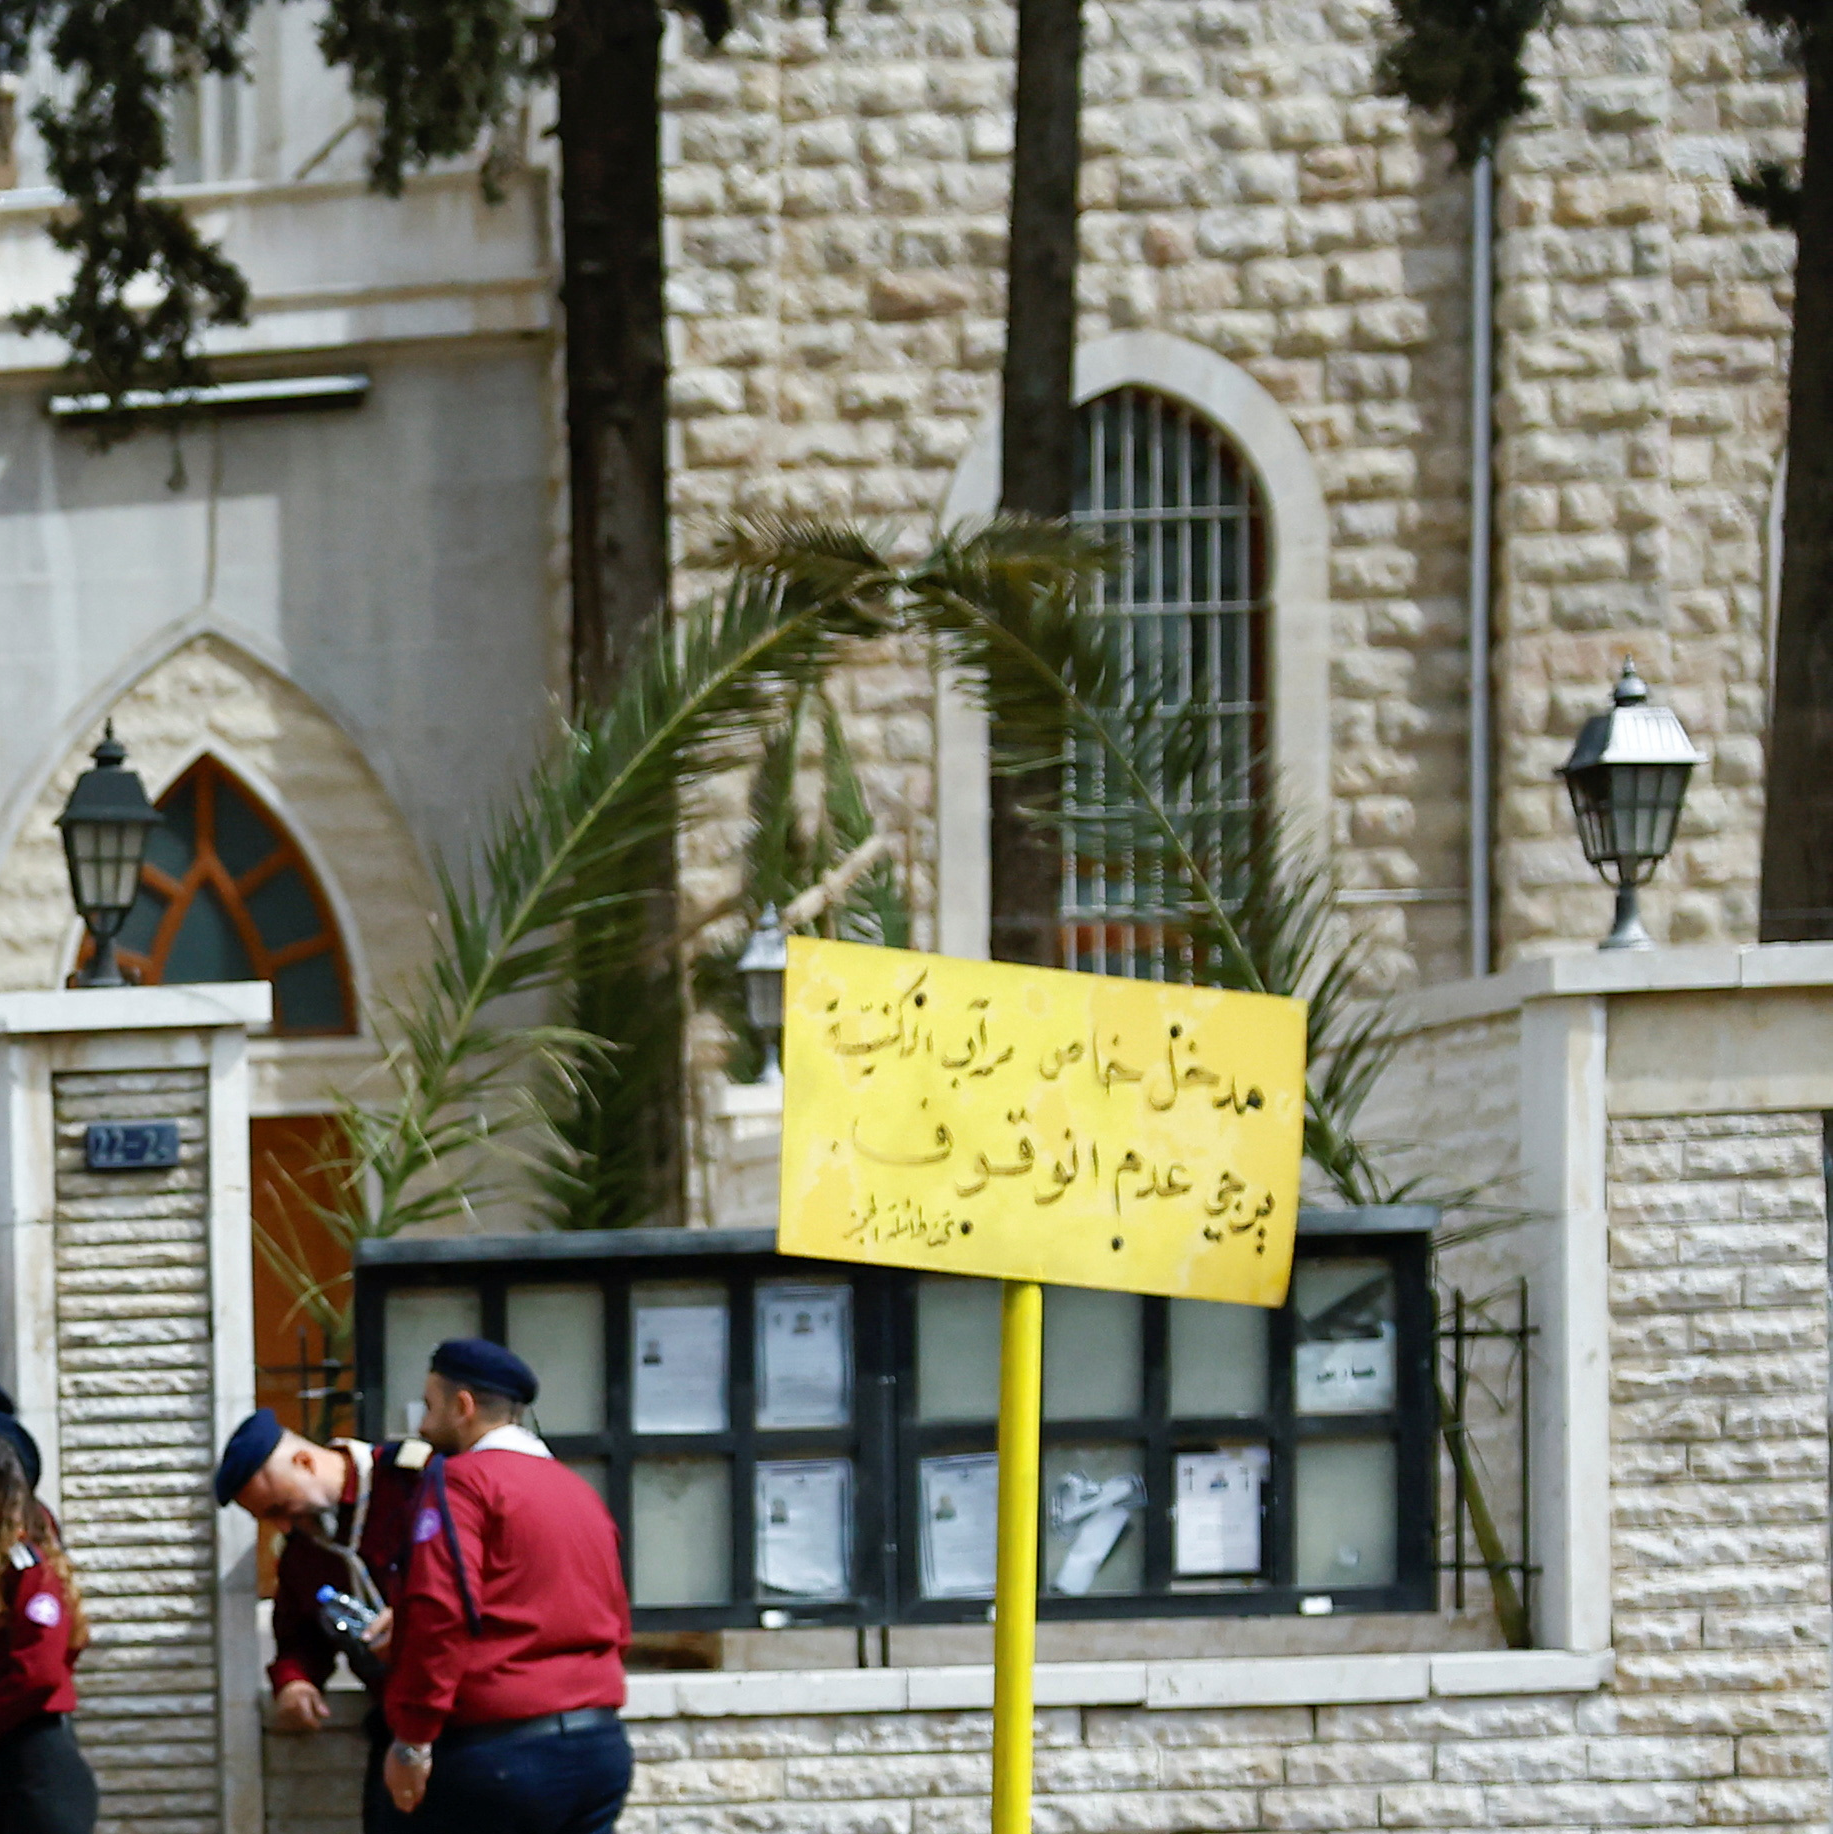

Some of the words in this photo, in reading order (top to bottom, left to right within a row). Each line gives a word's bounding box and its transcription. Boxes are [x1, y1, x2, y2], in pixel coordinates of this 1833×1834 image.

[1039, 1024, 1143, 1096] خاص
[1148, 1036, 1265, 1116] مدخل
[853, 1097, 1099, 1206] الوقوف
[1115, 1150, 1193, 1216] عدم
